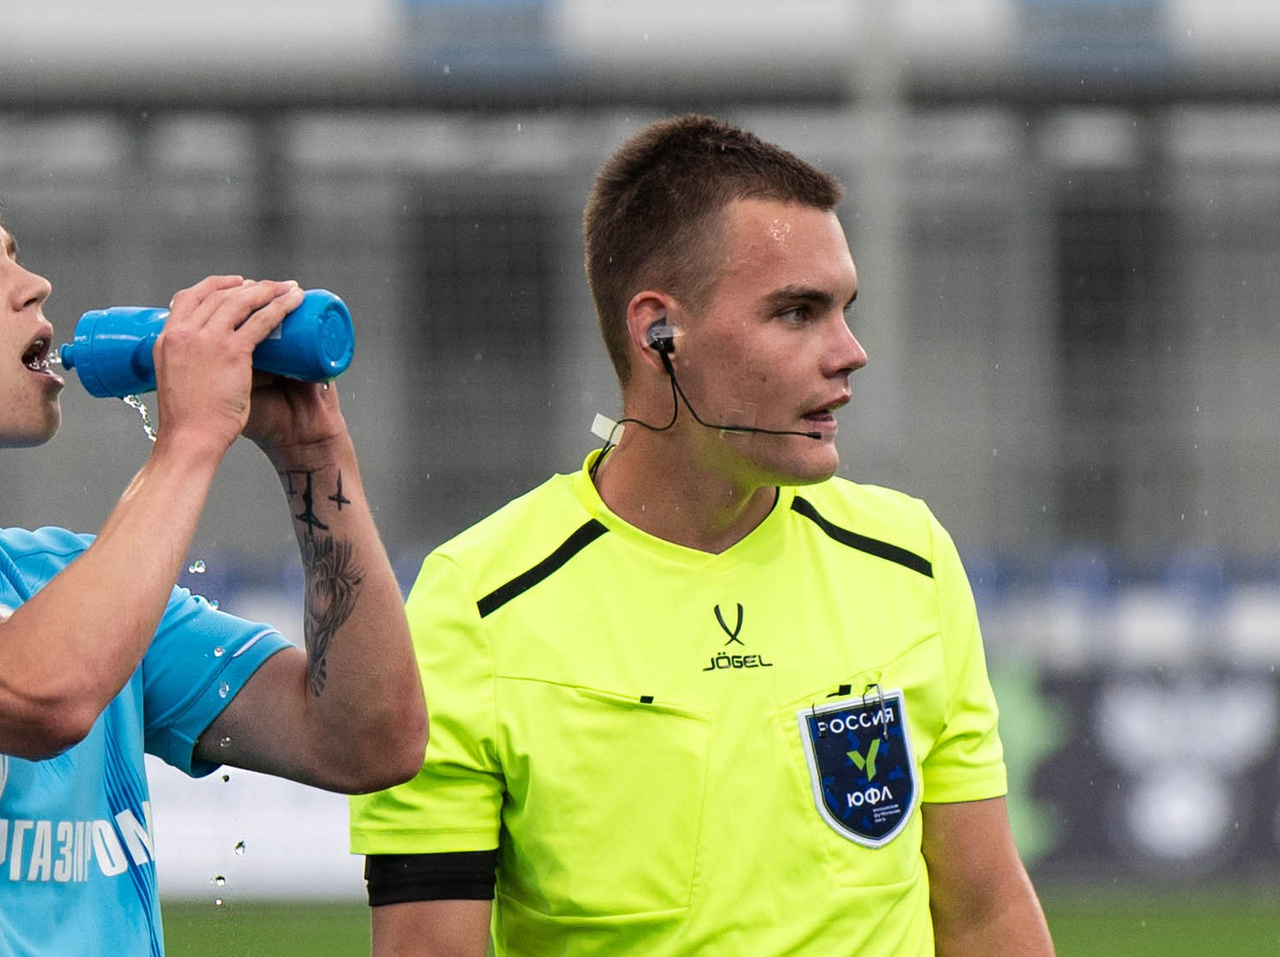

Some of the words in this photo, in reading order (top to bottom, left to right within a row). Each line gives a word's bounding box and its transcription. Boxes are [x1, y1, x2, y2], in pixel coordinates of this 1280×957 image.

[702, 651, 774, 672] JÖGEL
[817, 707, 896, 738] РОССИЯ
[846, 785, 894, 808] ЮФЛ
